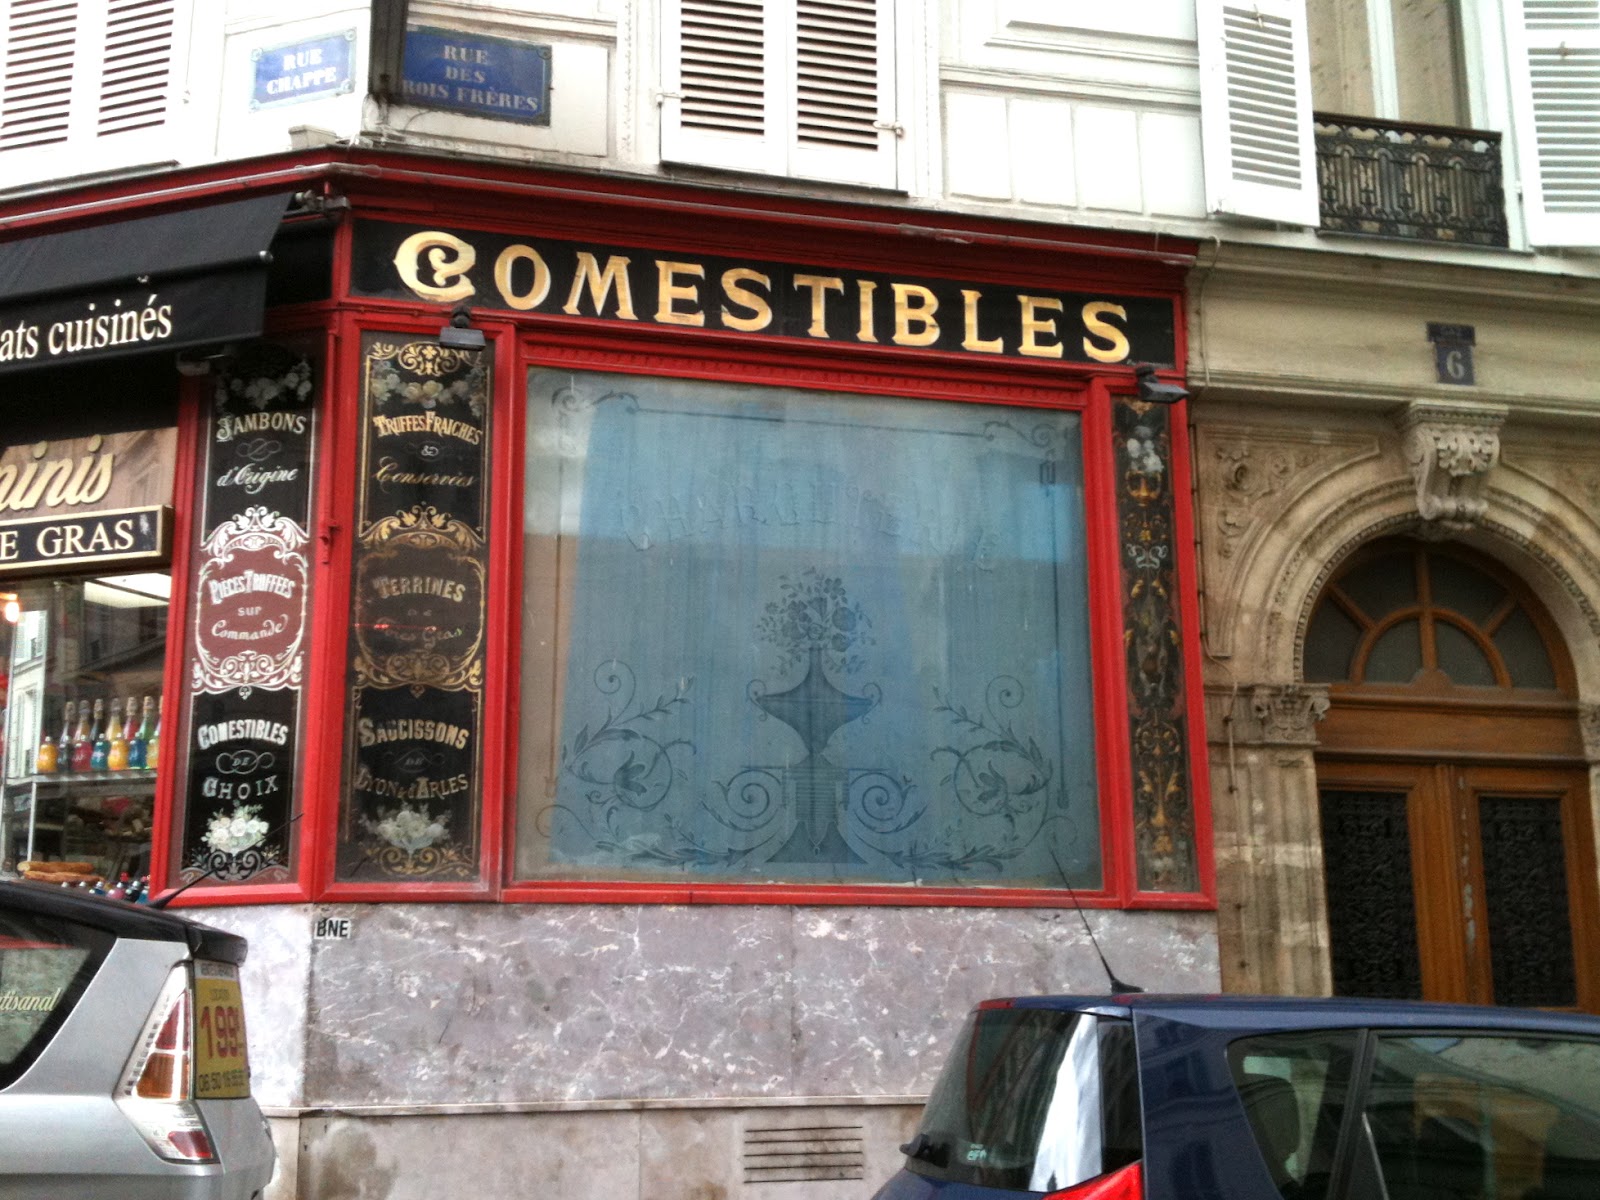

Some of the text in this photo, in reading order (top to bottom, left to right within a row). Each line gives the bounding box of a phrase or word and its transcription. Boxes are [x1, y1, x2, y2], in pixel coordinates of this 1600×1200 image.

[283, 48, 323, 71] RUE
[444, 45, 488, 64] RUE
[266, 66, 337, 95] CHAPPE
[444, 66, 486, 83] DES
[402, 80, 539, 111] ROIS FRÈRES
[393, 230, 1131, 363] COMESTIBLES
[48, 294, 172, 355] cuisinés
[1446, 350, 1465, 379] 6
[216, 412, 307, 442] JAMBONS
[373, 414, 426, 437] TRUFFES
[36, 519, 134, 557] GRAS
[372, 576, 466, 602] TERRINES
[237, 606, 262, 616] sur
[211, 613, 288, 640] Commande
[197, 719, 289, 750] COMESTIBLES
[359, 718, 470, 750] SAUCISSONS
[202, 775, 279, 799] CHOIX
[316, 918, 349, 938] BNE
